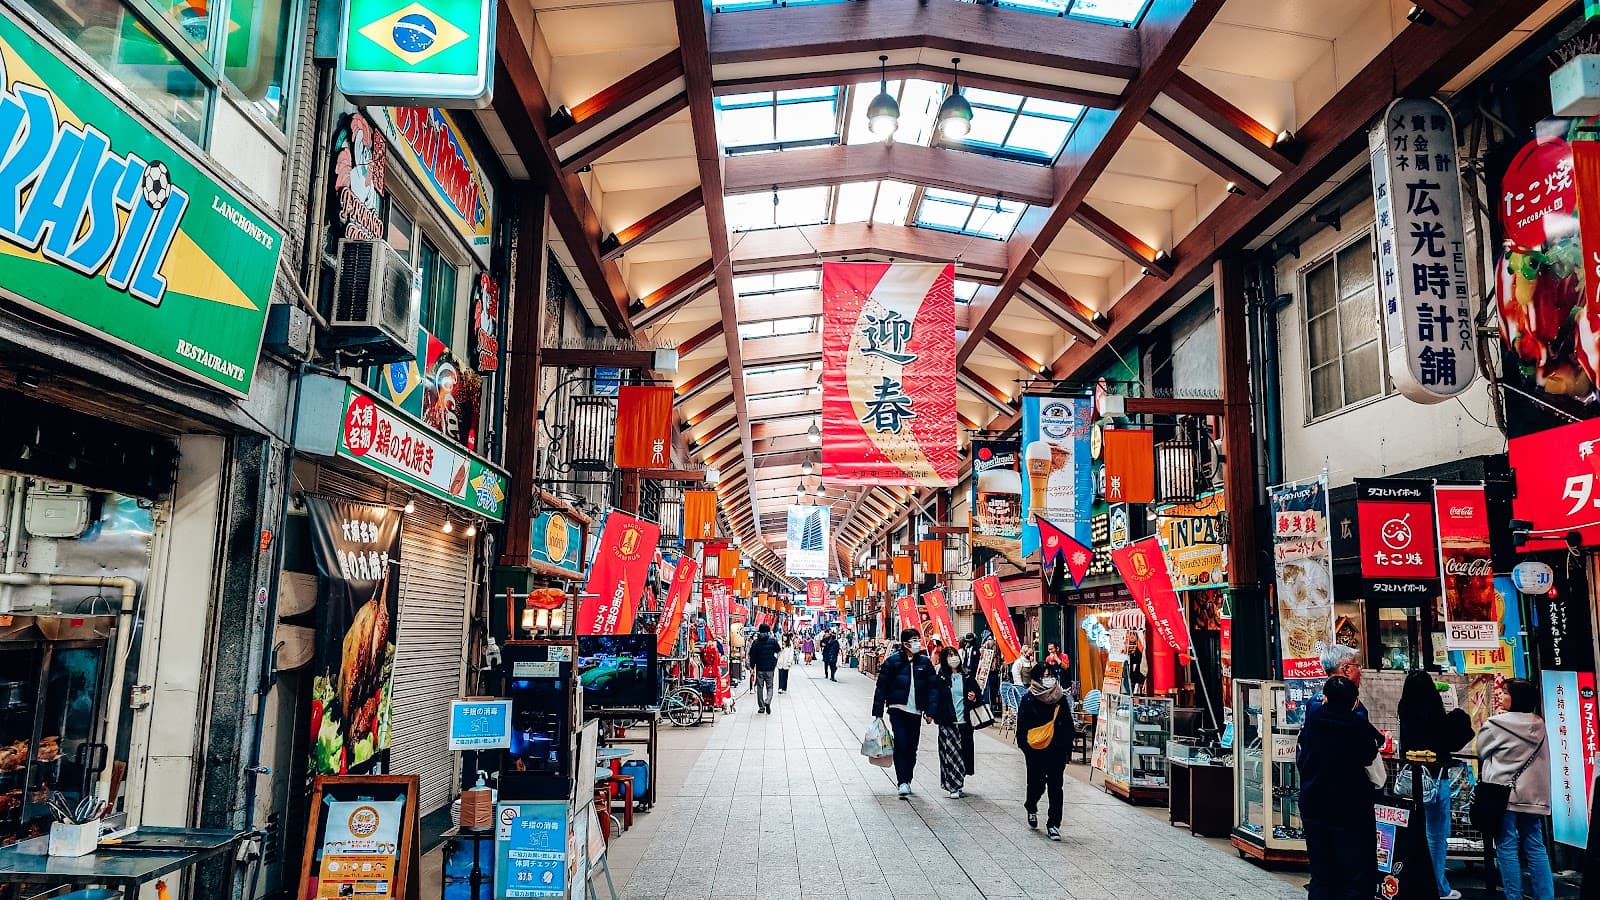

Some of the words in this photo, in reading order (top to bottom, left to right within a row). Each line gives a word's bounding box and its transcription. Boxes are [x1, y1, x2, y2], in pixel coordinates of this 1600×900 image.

[1392, 115, 1410, 172] メガネ
[1411, 114, 1430, 172] 貴金属
[1431, 115, 1451, 172] 時計
[1504, 159, 1573, 217] たこ焼
[213, 194, 275, 250] LANCHONETE
[1516, 205, 1553, 228] TACOBALL
[1406, 179, 1457, 386] 広光時計舗
[176, 339, 247, 383] RESTAURANTE
[860, 310, 918, 434] 迎春
[350, 406, 374, 427] 大須
[350, 426, 372, 450] 名物
[1367, 487, 1421, 497] タコとハイボール
[1562, 473, 1600, 517] タ
[341, 518, 379, 543] 大須名物
[1374, 550, 1423, 566] たこ焼
[1445, 557, 1493, 577] Coca-Cola
[1373, 583, 1427, 593] タコとハイボール
[1548, 601, 1562, 666] 九条ねぎマヨ
[1584, 702, 1596, 765] タコとハイボール
[1375, 805, 1408, 826] 日限定
[515, 860, 558, 868] 体調チェック
